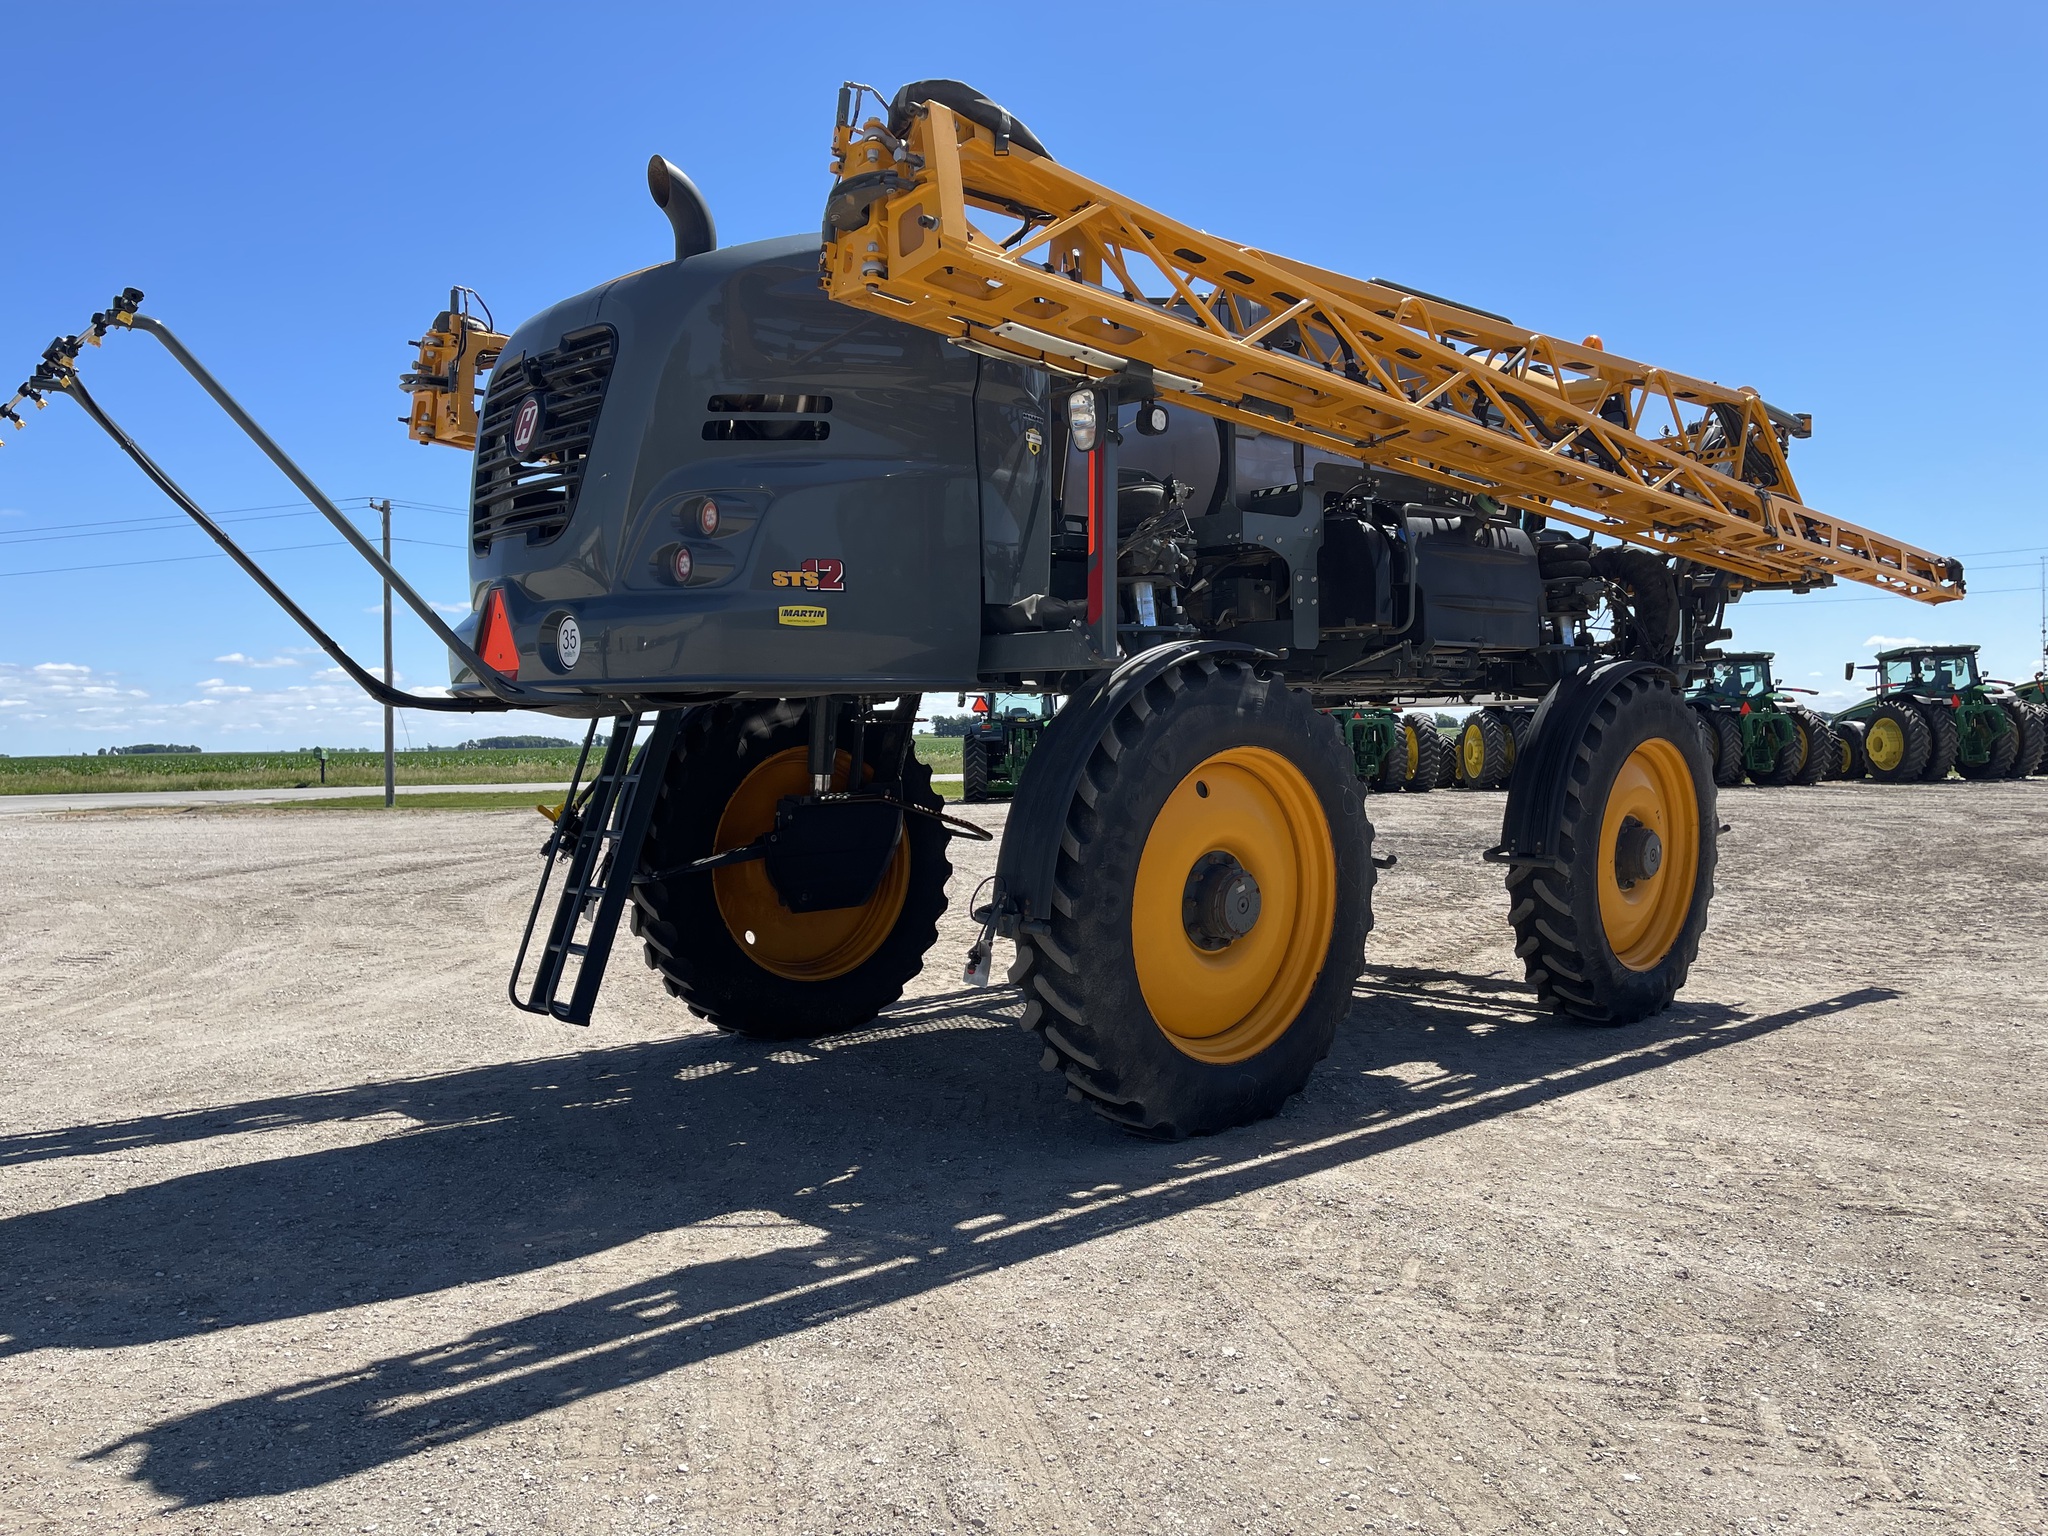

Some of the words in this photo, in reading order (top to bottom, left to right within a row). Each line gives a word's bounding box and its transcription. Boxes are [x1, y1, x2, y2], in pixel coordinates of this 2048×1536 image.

[772, 571, 819, 587] STS
[801, 559, 844, 591] 12
[783, 609, 825, 618] MARTIN
[562, 629, 577, 650] 35
